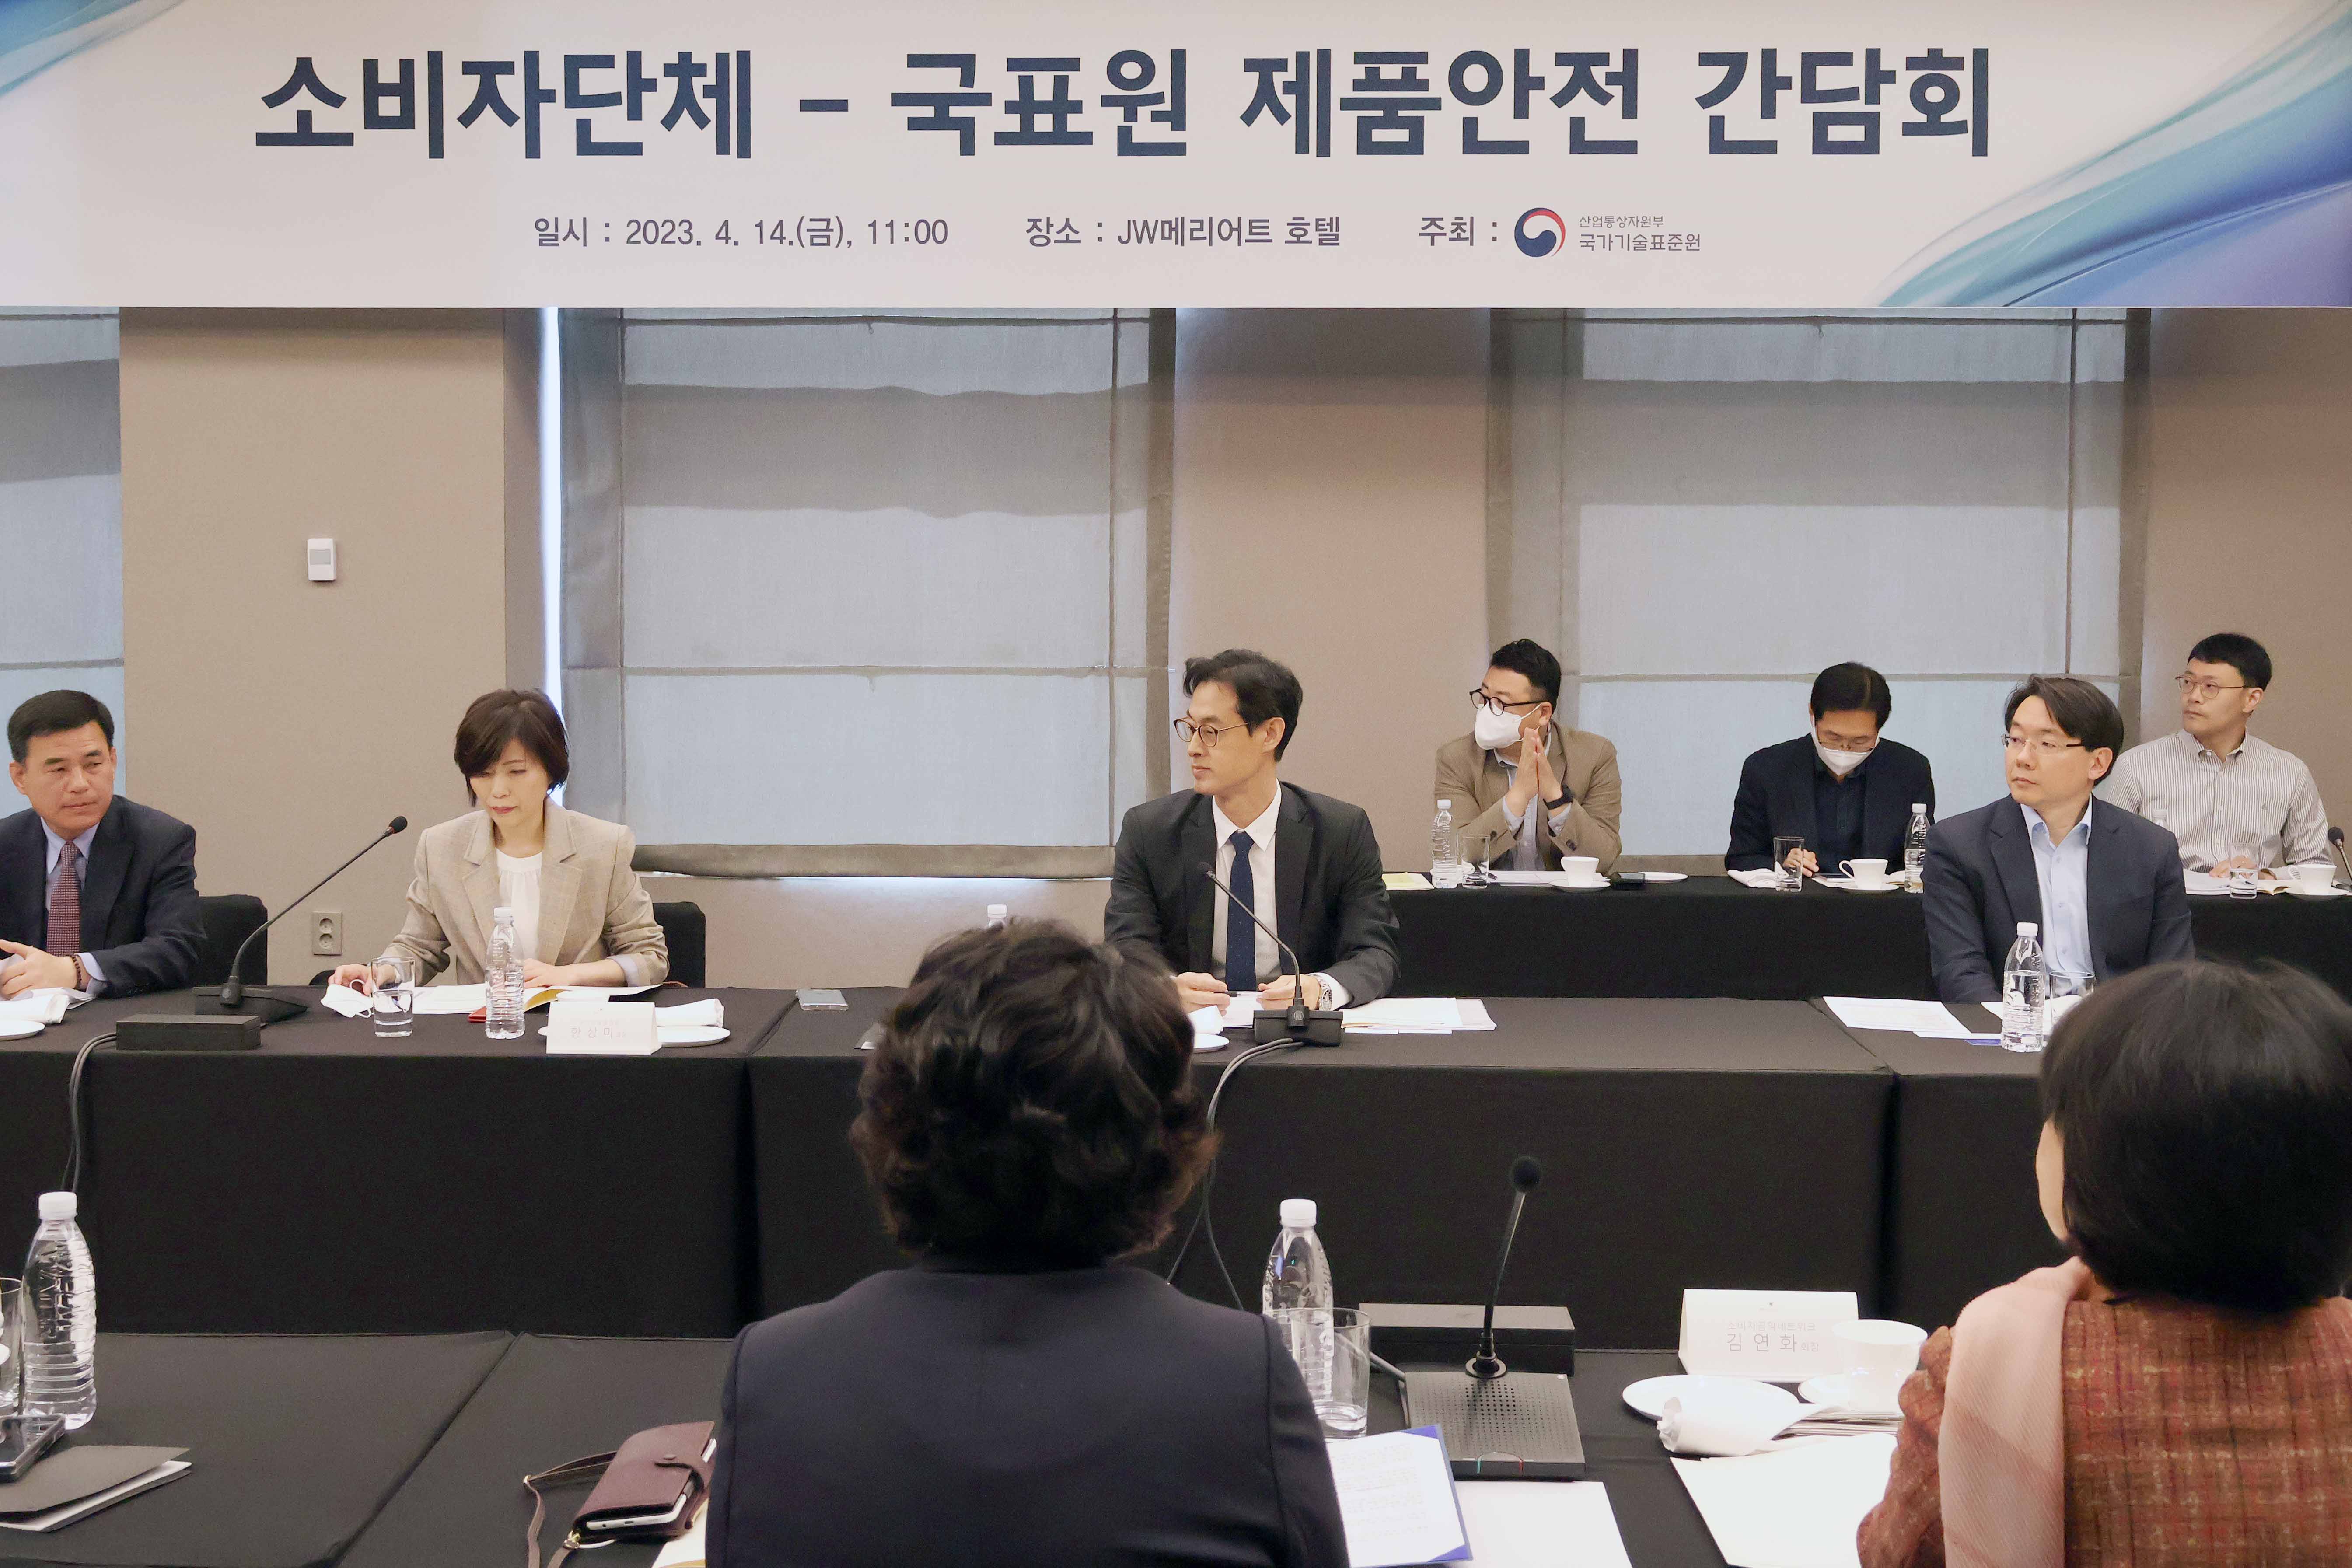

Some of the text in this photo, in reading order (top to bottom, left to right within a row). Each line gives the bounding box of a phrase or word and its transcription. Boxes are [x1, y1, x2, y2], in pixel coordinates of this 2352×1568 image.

[256, 50, 751, 159] 소비자단체
[891, 49, 1187, 156] 국표원
[1240, 49, 1638, 157] 제품안전
[1695, 48, 1989, 157] 간담회
[535, 217, 587, 247] 일시
[626, 219, 701, 246] 2023.
[715, 220, 739, 246] 4.
[755, 216, 852, 248] 14.(금),
[868, 219, 948, 244] 11:00
[1026, 217, 1081, 247] 장소
[1118, 217, 1273, 246] JW메리어트
[1284, 217, 1340, 246] 호텔
[1419, 216, 1474, 246] 주최
[1579, 216, 1664, 228] 산업통상자원부
[1579, 234, 1700, 251] 국가기술표준원
